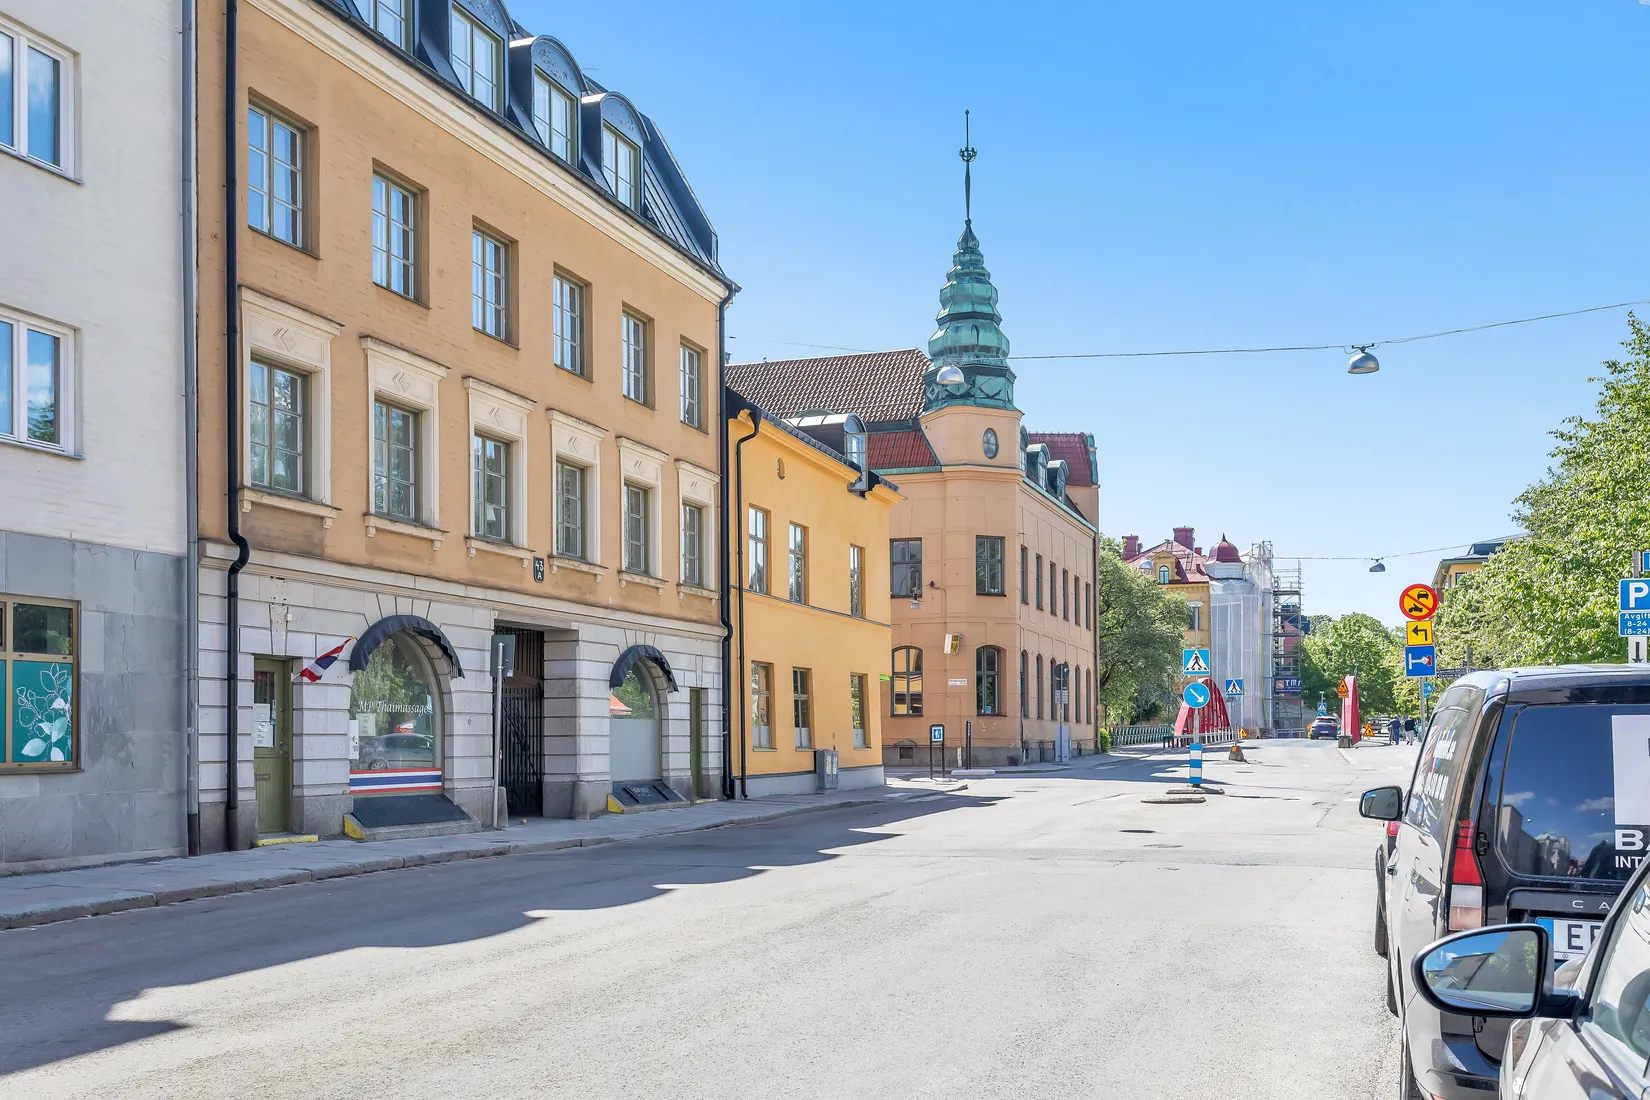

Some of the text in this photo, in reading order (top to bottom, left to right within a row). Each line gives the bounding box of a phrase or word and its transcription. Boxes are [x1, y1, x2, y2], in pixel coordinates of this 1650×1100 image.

[535, 560, 544, 571] 43
[537, 571, 542, 579] A
[1629, 582, 1649, 608] P
[357, 700, 428, 717] MP Thaimassage
[1615, 829, 1650, 850] B
[1615, 856, 1646, 868] INT
